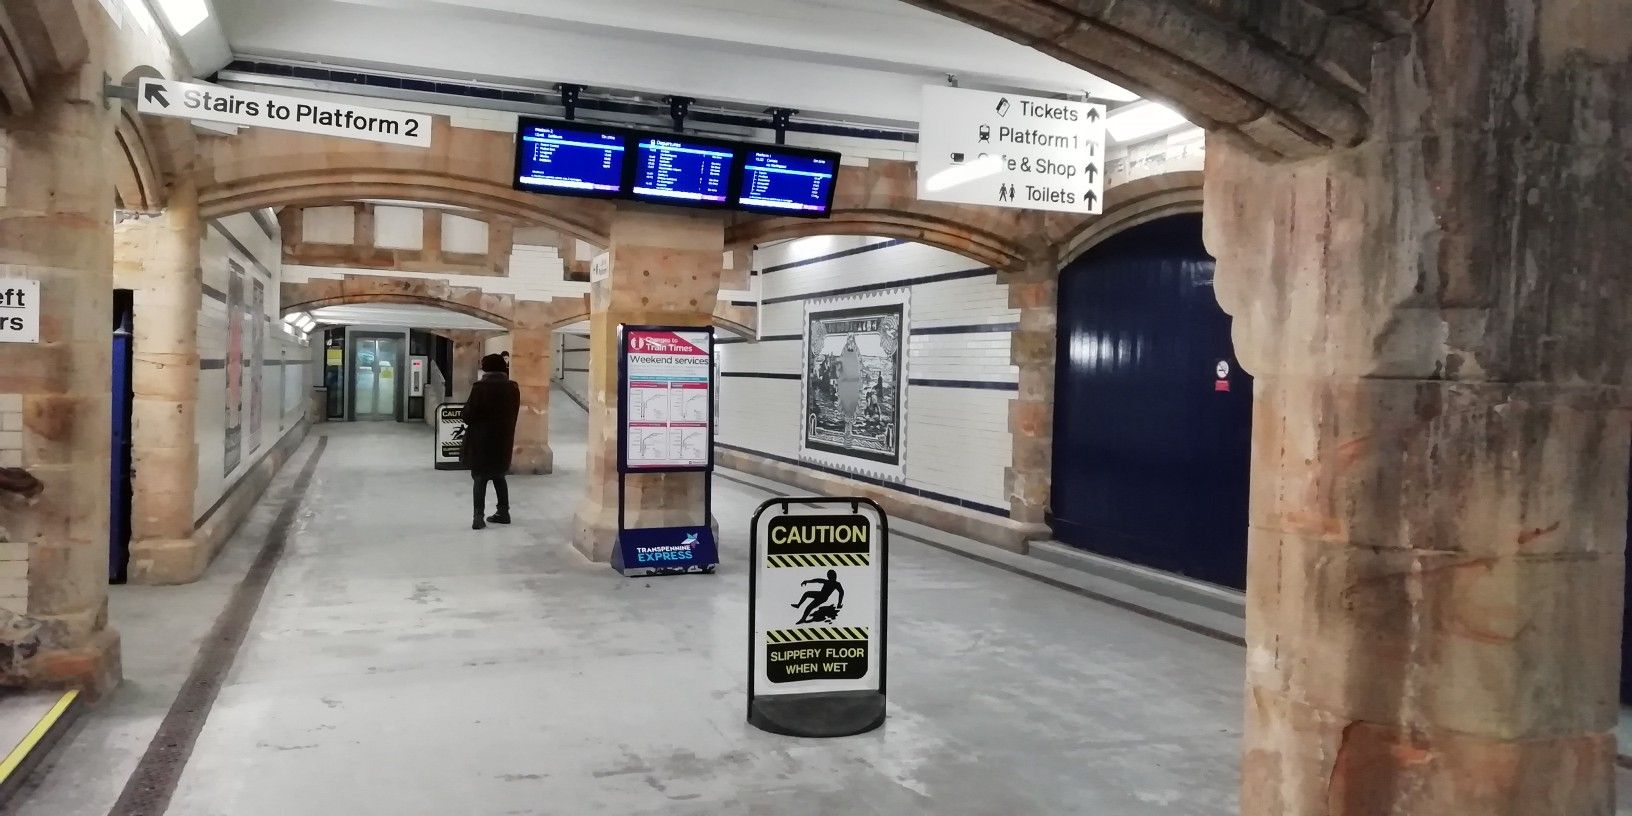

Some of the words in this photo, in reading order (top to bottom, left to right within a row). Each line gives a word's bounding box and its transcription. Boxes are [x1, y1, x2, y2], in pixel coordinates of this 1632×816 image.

[184, 89, 259, 116] Stairs
[267, 100, 290, 120] to
[296, 104, 399, 134] Platform
[405, 118, 419, 137] 2
[1020, 101, 1078, 121] Tickets
[999, 126, 1069, 149] Platform
[1072, 136, 1078, 149] 1
[1020, 156, 1032, 172] &
[1036, 158, 1077, 179] Shop
[1025, 185, 1075, 204] Toilets
[645, 343, 667, 352] Train
[668, 343, 693, 352] Times
[630, 355, 673, 364] Weekend
[675, 356, 709, 365] services
[771, 525, 867, 545] CAUTION
[636, 544, 691, 554] TRANSPENNINE
[638, 550, 693, 562] EXPRESS
[770, 648, 822, 662] SLIPPERY
[825, 647, 865, 659] FLOOR
[785, 662, 818, 675] WHEN
[823, 662, 848, 672] WET
